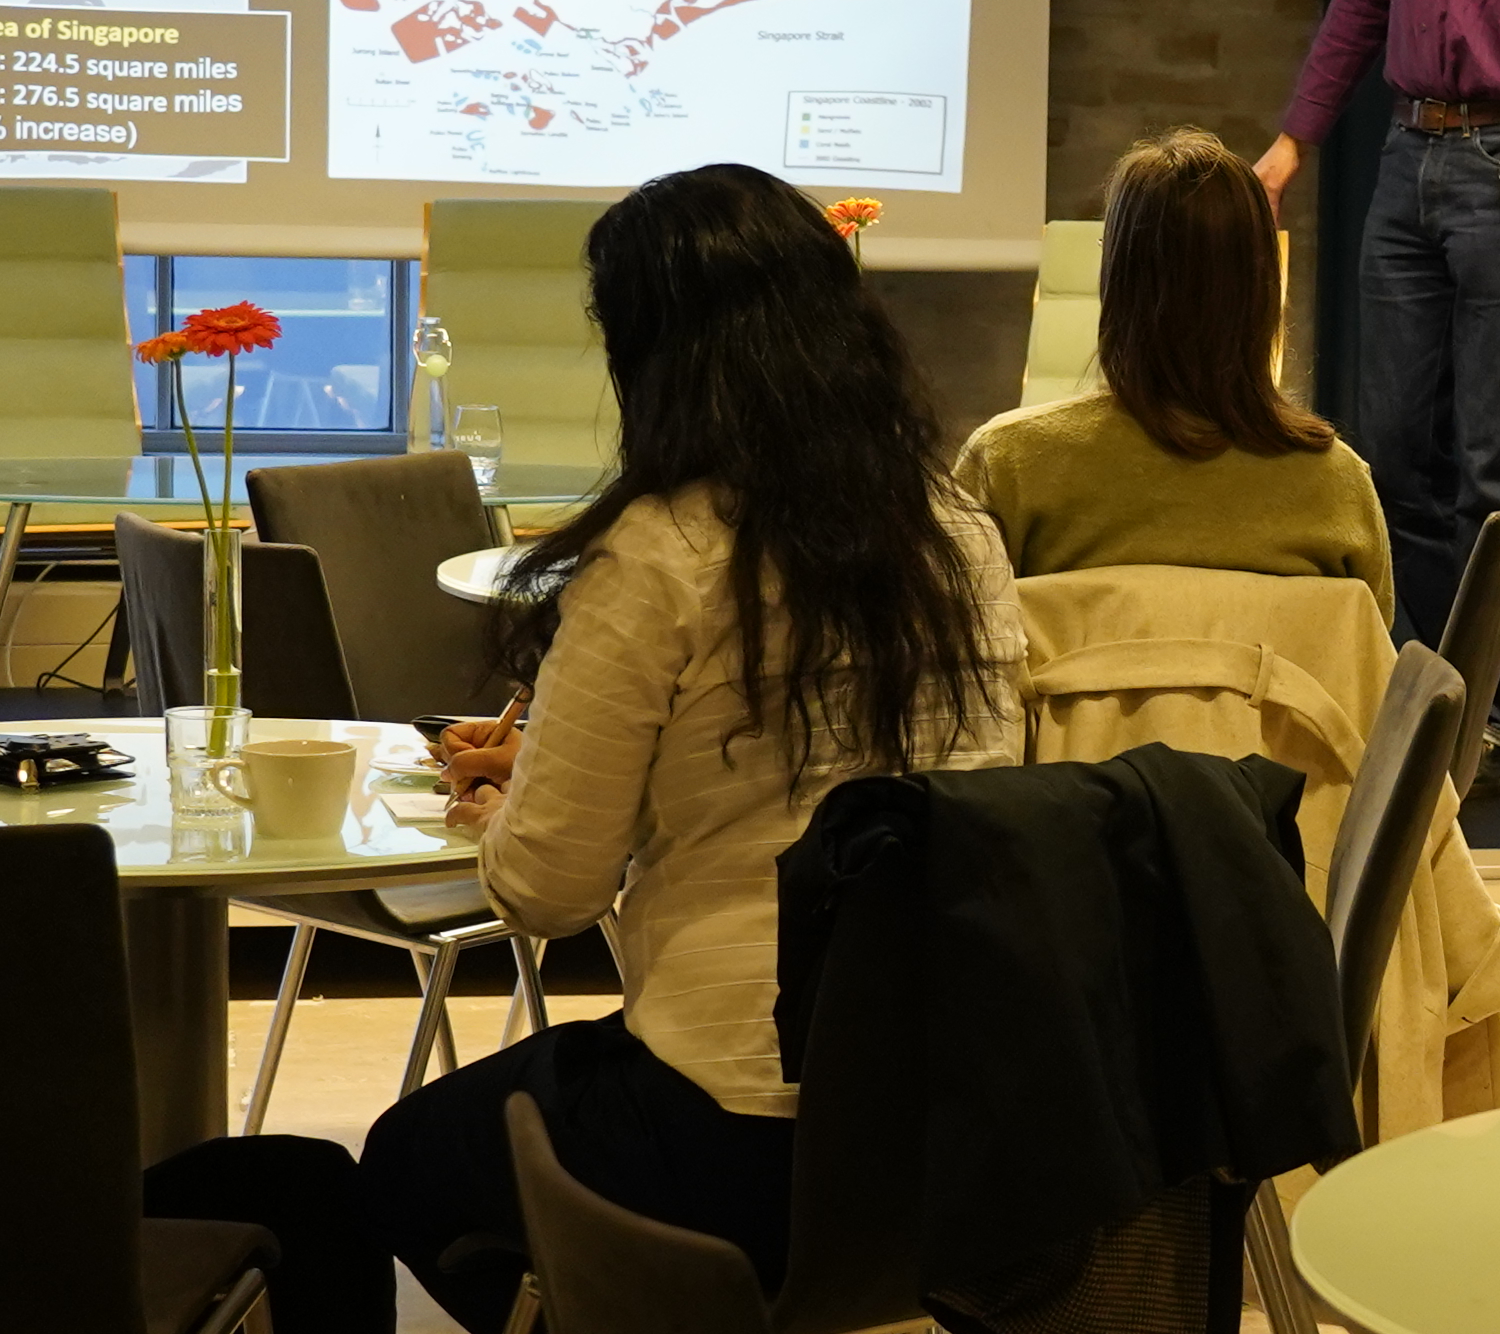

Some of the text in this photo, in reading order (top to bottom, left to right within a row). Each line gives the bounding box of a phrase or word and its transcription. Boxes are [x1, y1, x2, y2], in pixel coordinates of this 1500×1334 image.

[26, 18, 51, 39] of
[57, 19, 180, 47] Singapore
[757, 30, 845, 42] Singapore Strait
[12, 51, 79, 74] 224.5
[87, 58, 167, 80] square
[174, 57, 238, 79] miles
[12, 85, 79, 108] 276.5
[87, 92, 167, 115] square
[174, 90, 242, 113] miles
[803, 96, 850, 105] Singapore
[853, 95, 897, 106] Coastline
[908, 98, 932, 108] 2002
[15, 115, 138, 149] increase)
